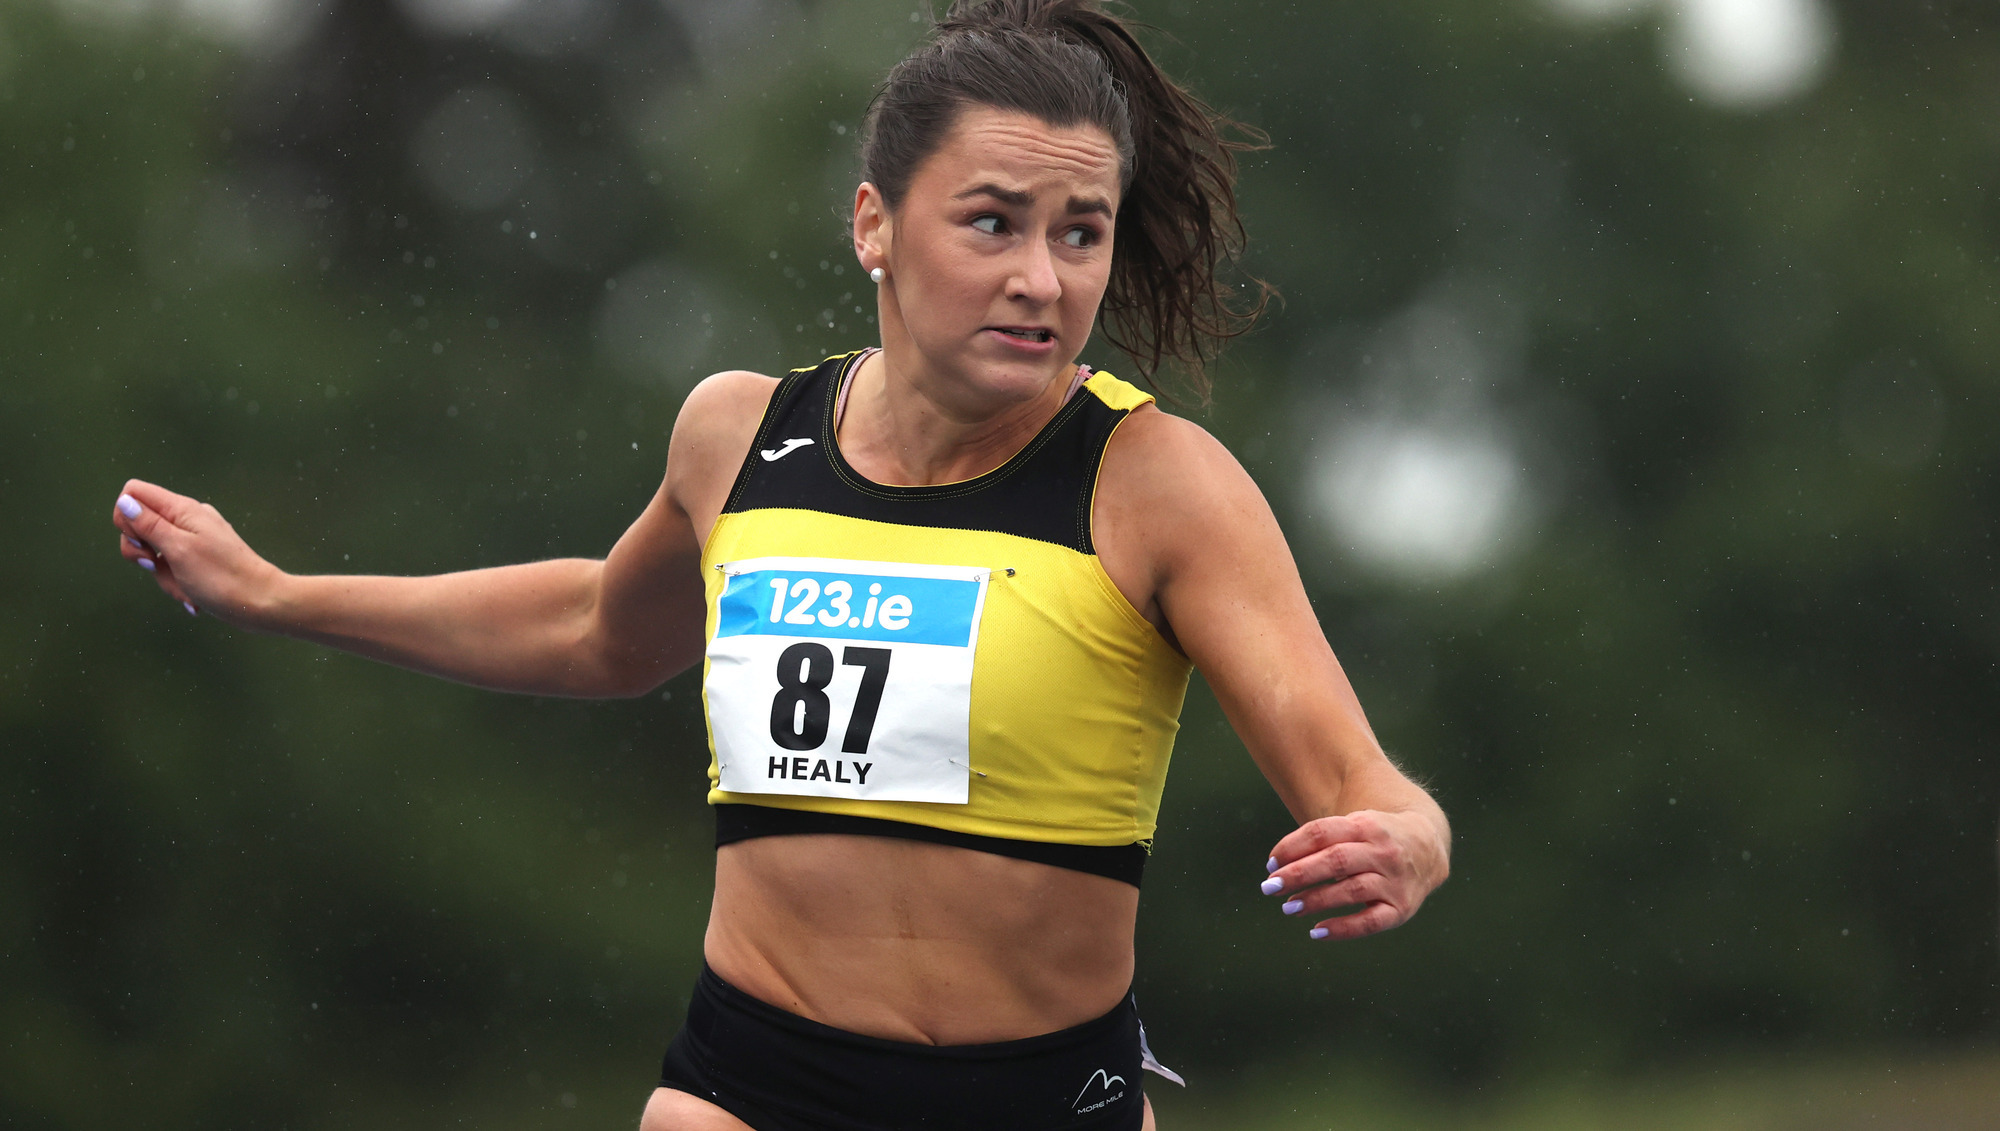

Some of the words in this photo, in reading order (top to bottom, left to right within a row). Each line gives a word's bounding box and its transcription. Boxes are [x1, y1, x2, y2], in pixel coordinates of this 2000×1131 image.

[769, 578, 913, 631] 123.ie
[769, 642, 892, 754] 87
[768, 756, 873, 785] HEALY
[1077, 1101, 1105, 1115] MORE
[1106, 1091, 1124, 1105] MILE
